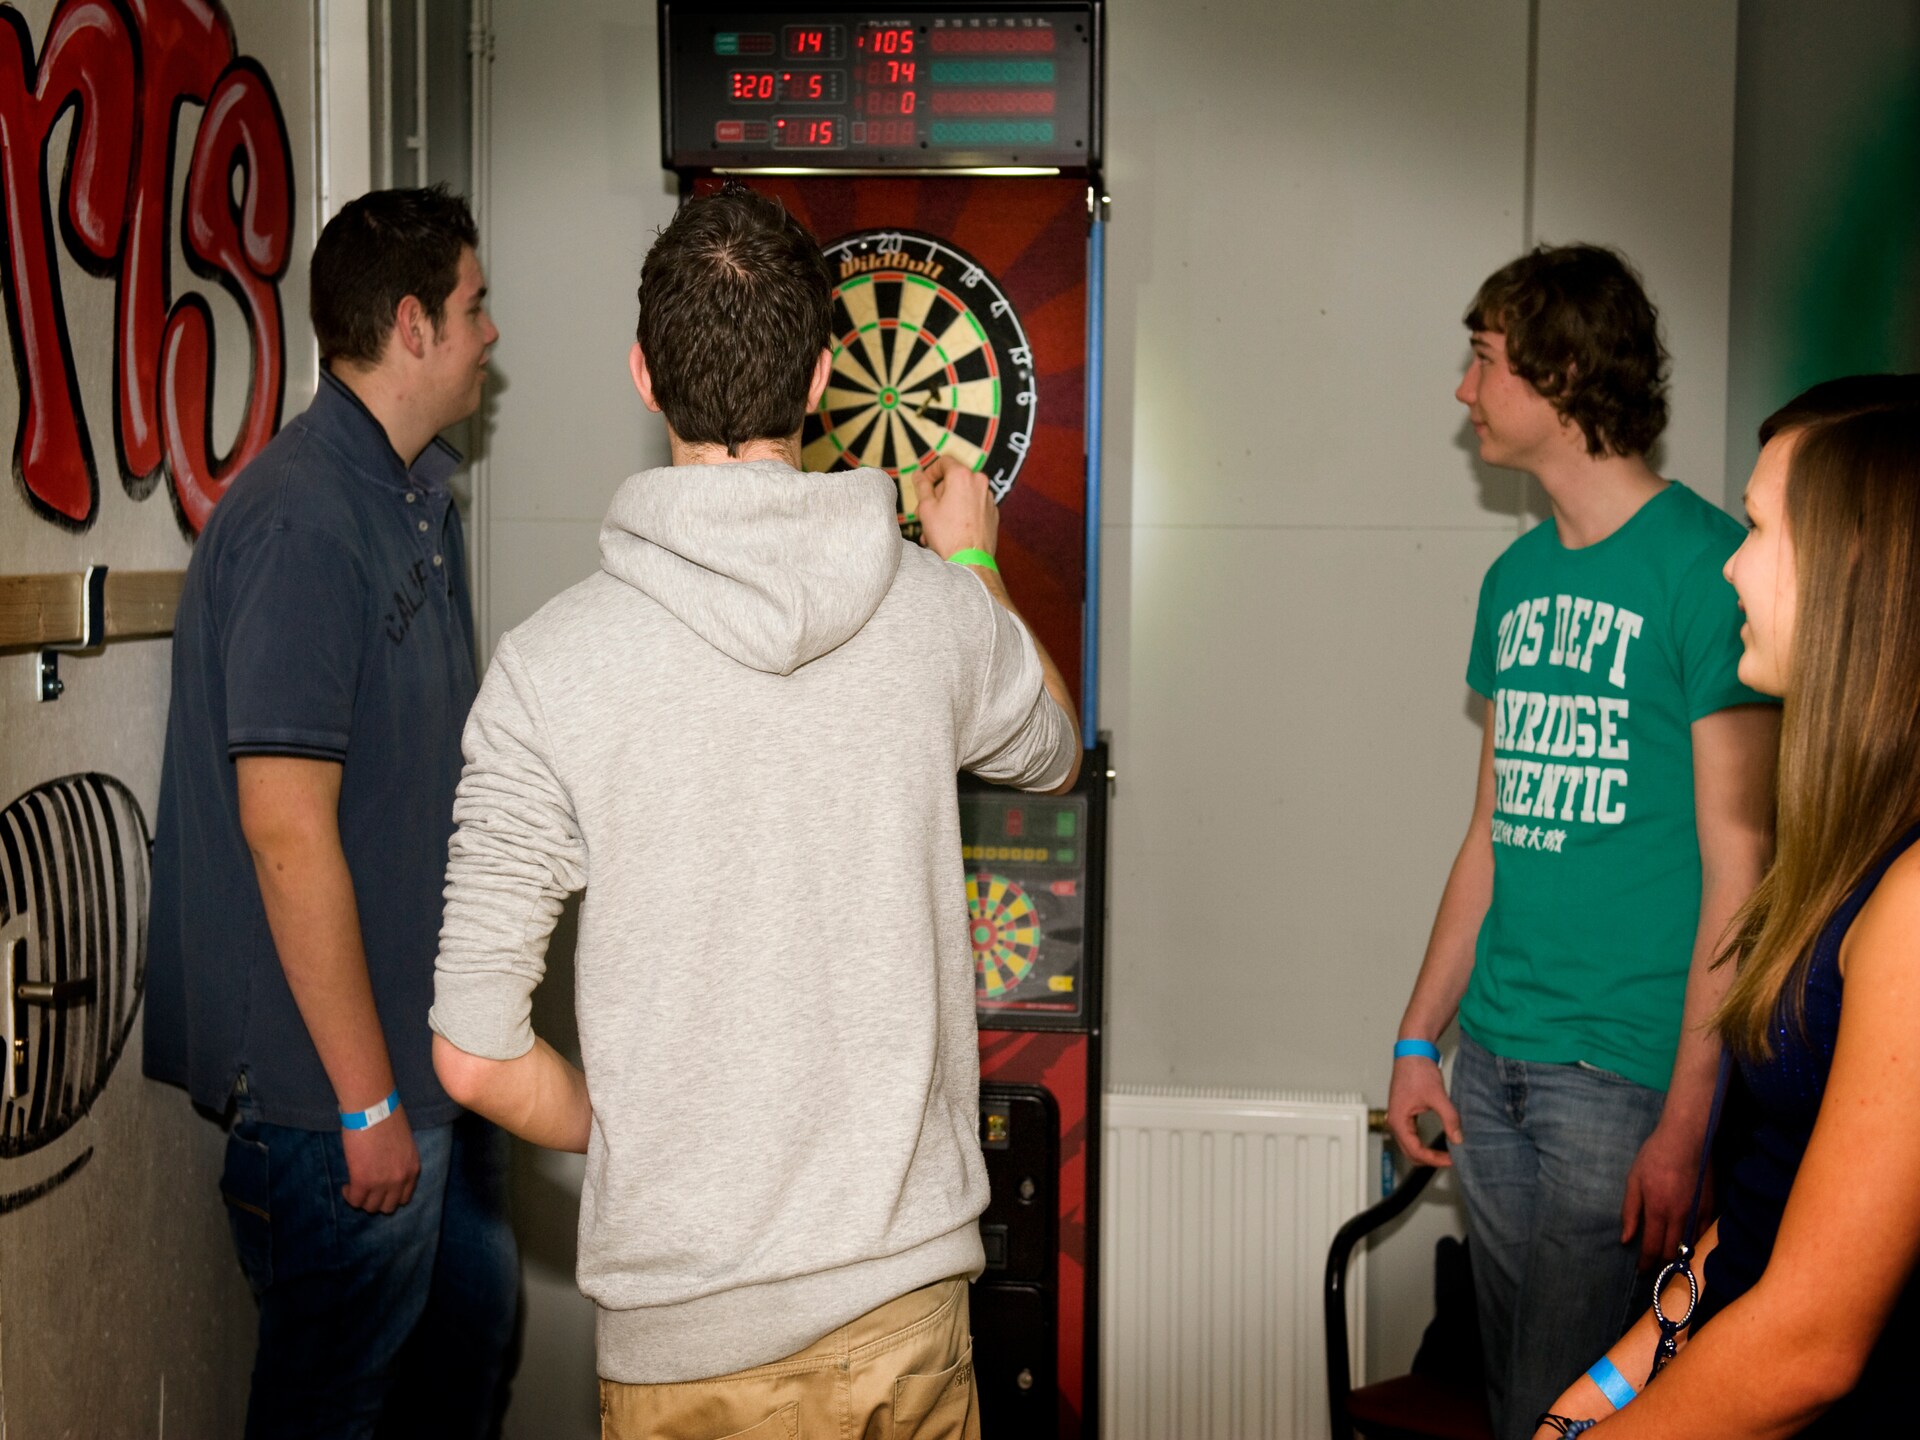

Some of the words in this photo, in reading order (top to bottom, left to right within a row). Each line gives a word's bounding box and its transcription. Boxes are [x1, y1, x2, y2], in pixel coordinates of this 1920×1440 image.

[798, 32, 822, 53] 14
[873, 30, 914, 53] 105
[887, 62, 915, 84] 74
[743, 75, 774, 98] 20
[809, 75, 822, 98] 5
[900, 91, 915, 114] 0
[809, 121, 832, 144] 15
[876, 232, 902, 254] 20
[959, 266, 984, 288] 18
[990, 300, 1009, 319] 4
[1016, 391, 1036, 405] 6
[1008, 432, 1029, 454] 10
[1549, 594, 1644, 689] DEPT
[1493, 688, 1629, 760] AYRIDGE
